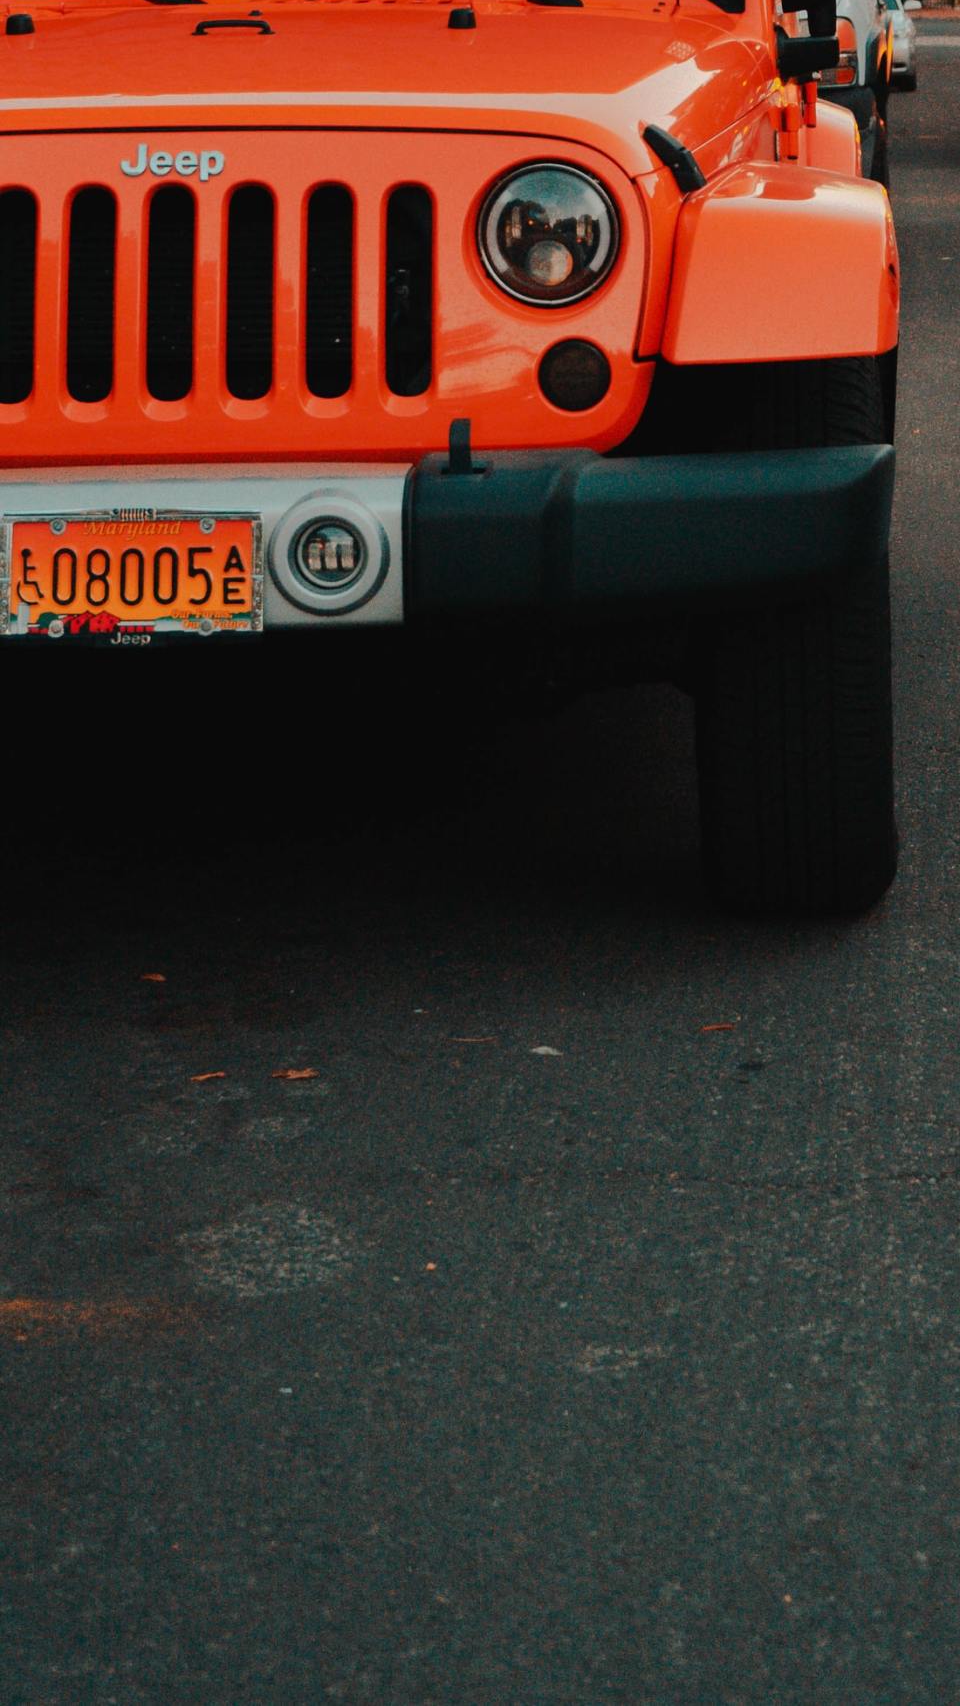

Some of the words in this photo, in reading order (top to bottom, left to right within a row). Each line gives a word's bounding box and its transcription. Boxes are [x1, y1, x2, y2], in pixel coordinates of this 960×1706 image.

[120, 143, 225, 182] Jeep
[83, 521, 182, 540] Maryland
[52, 547, 213, 606] 08005
[110, 632, 151, 647] Jeep
